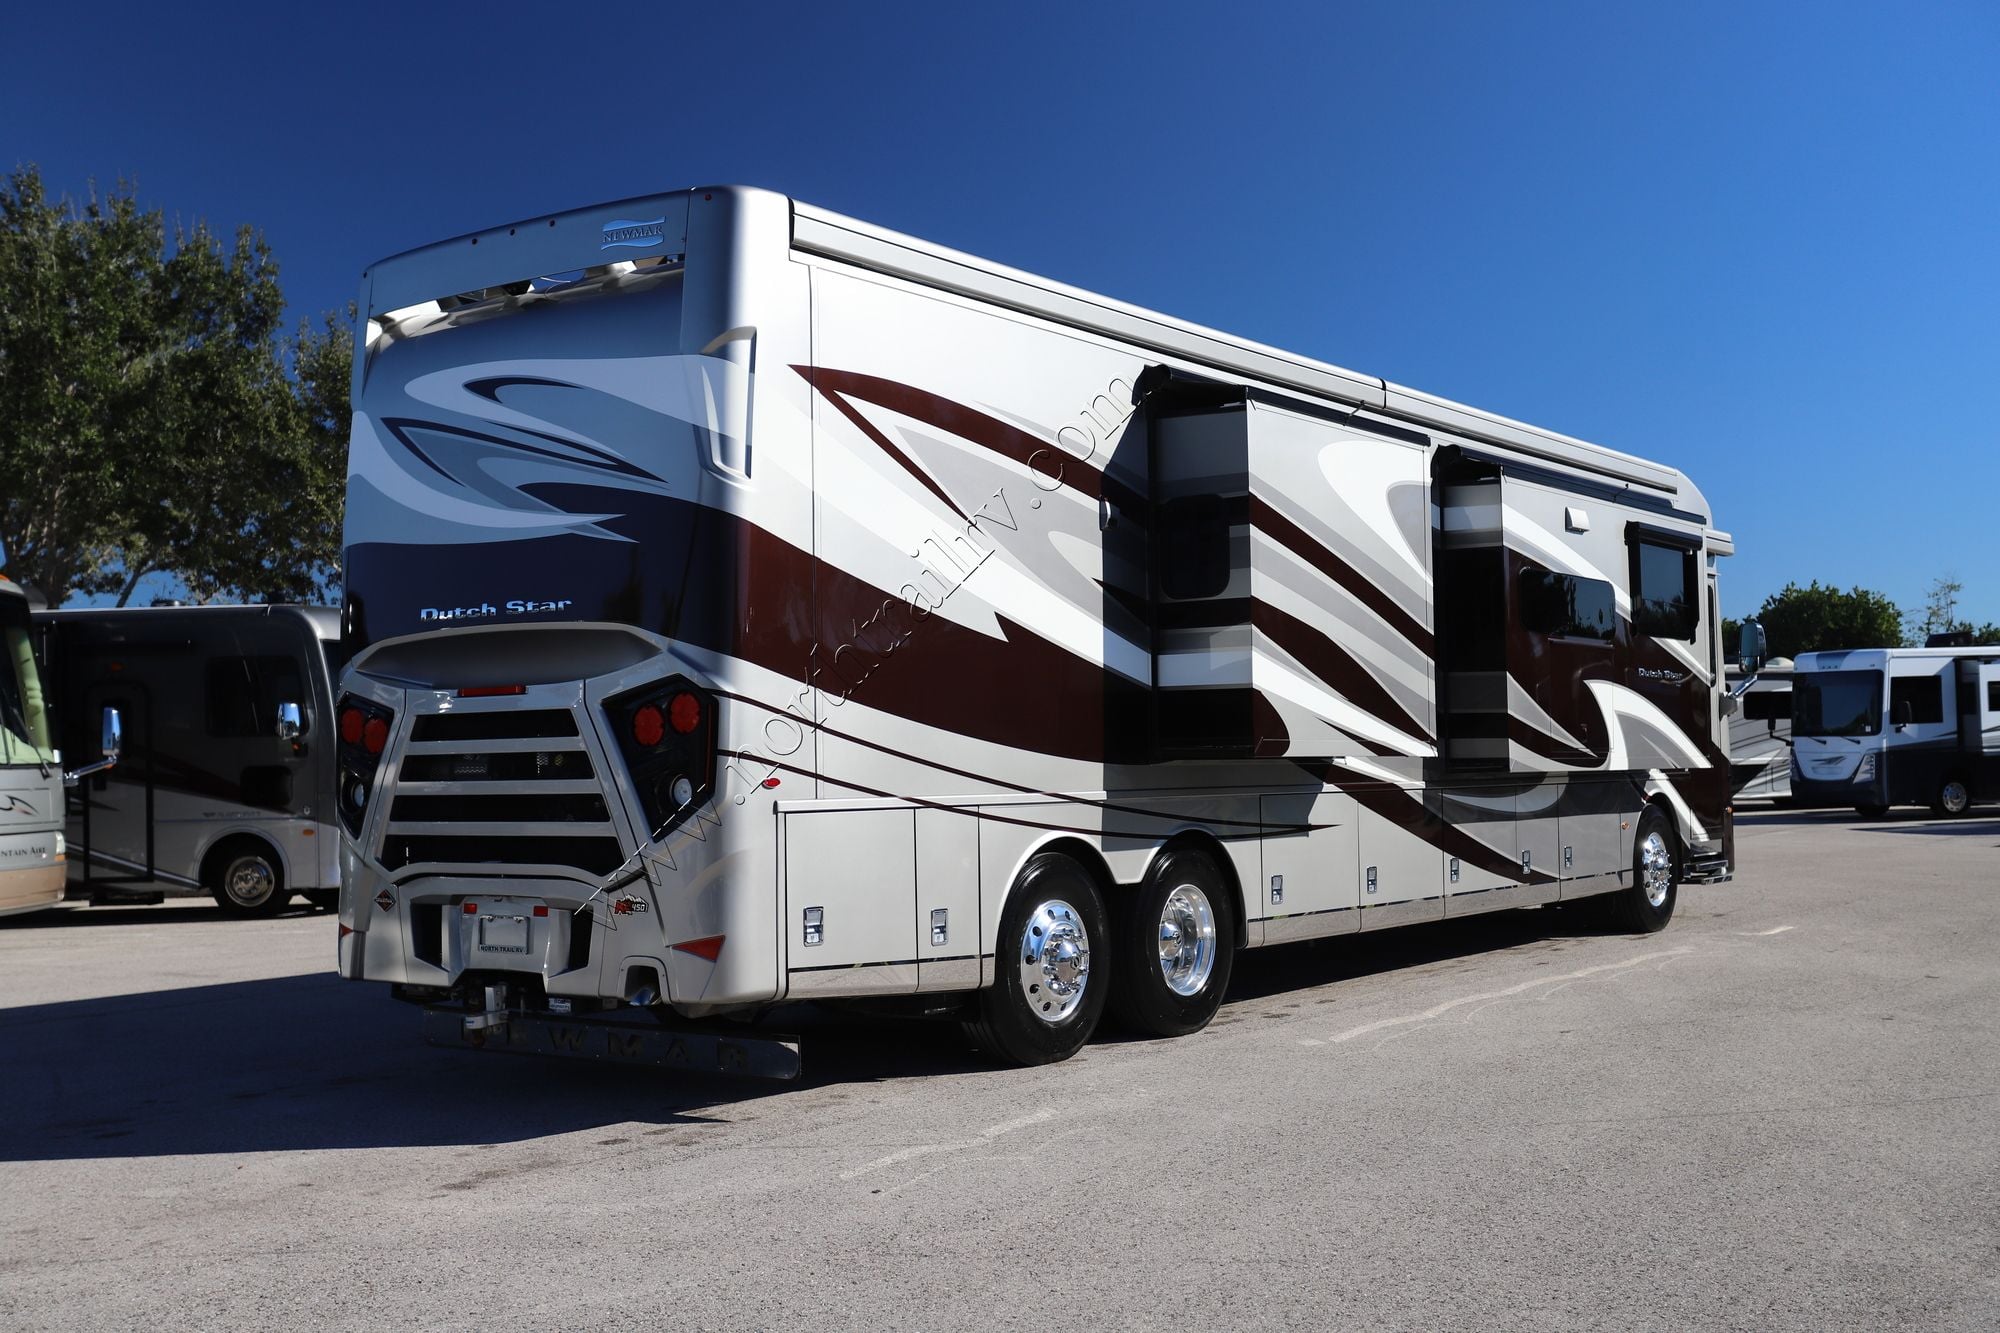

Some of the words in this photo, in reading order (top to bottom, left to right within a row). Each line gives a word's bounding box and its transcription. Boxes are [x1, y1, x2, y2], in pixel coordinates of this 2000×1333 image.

[602, 225, 663, 243] NEWMAR
[420, 602, 497, 622] Dutch
[506, 599, 573, 615] Star
[1638, 667, 1663, 679] Dutch
[1664, 670, 1683, 680] Star
[631, 902, 647, 912] 450
